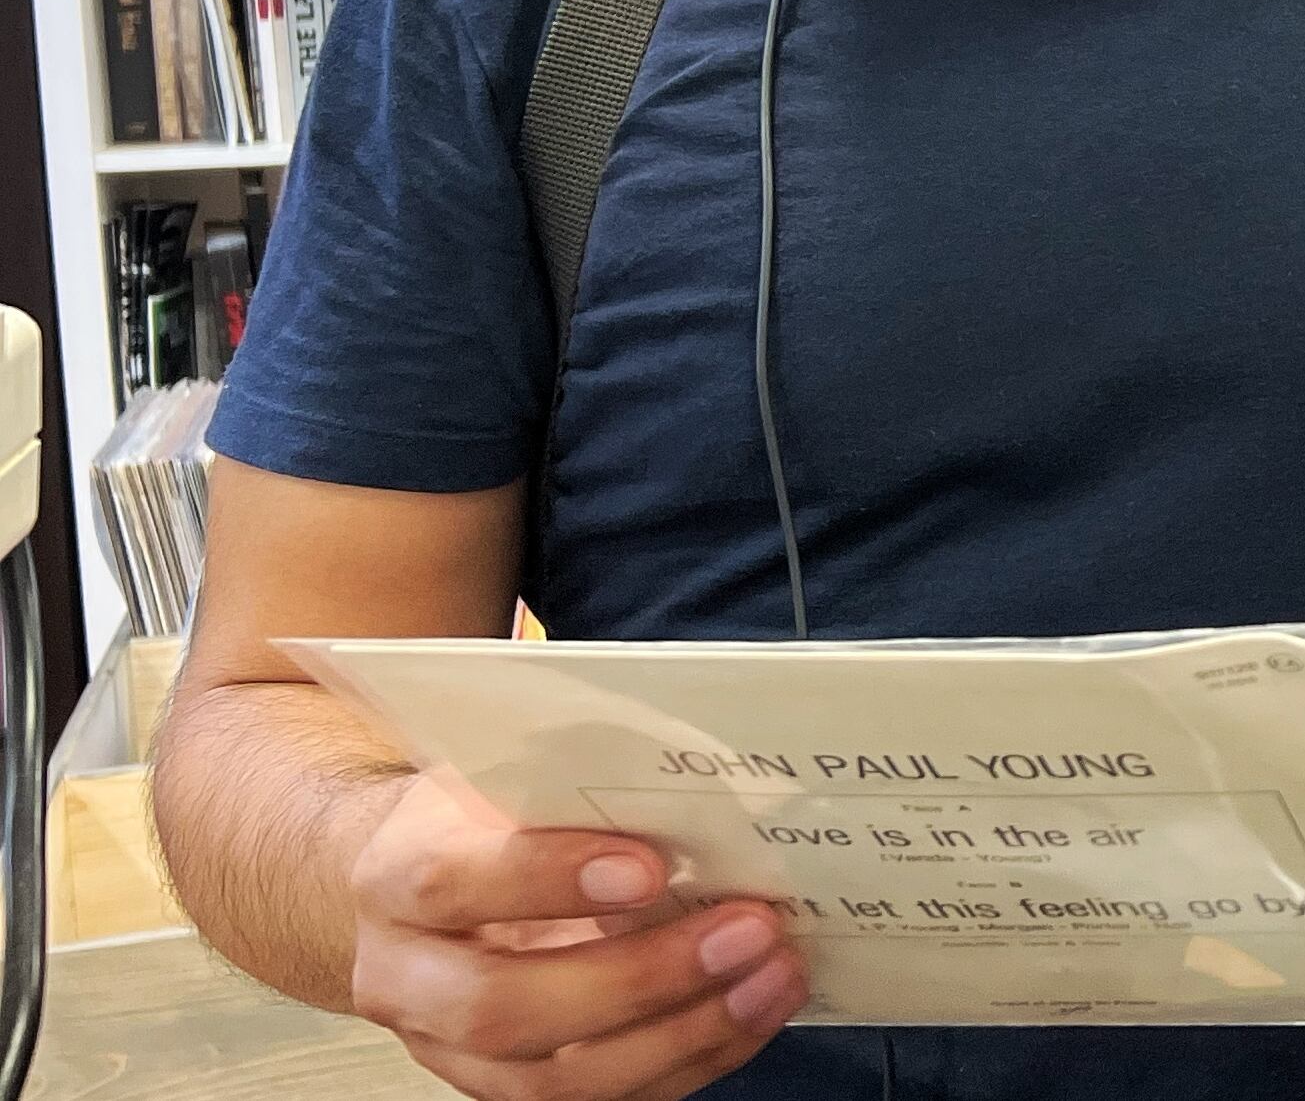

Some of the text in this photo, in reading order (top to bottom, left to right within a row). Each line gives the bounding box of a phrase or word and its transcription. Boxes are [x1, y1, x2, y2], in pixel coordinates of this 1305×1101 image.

[658, 749, 1157, 779] JOHN PAUL YOUNG
[753, 821, 1145, 848] love is in the air
[837, 897, 903, 918] let
[916, 898, 1003, 919] this
[1018, 897, 1170, 920] feeling
[1186, 898, 1242, 919] go
